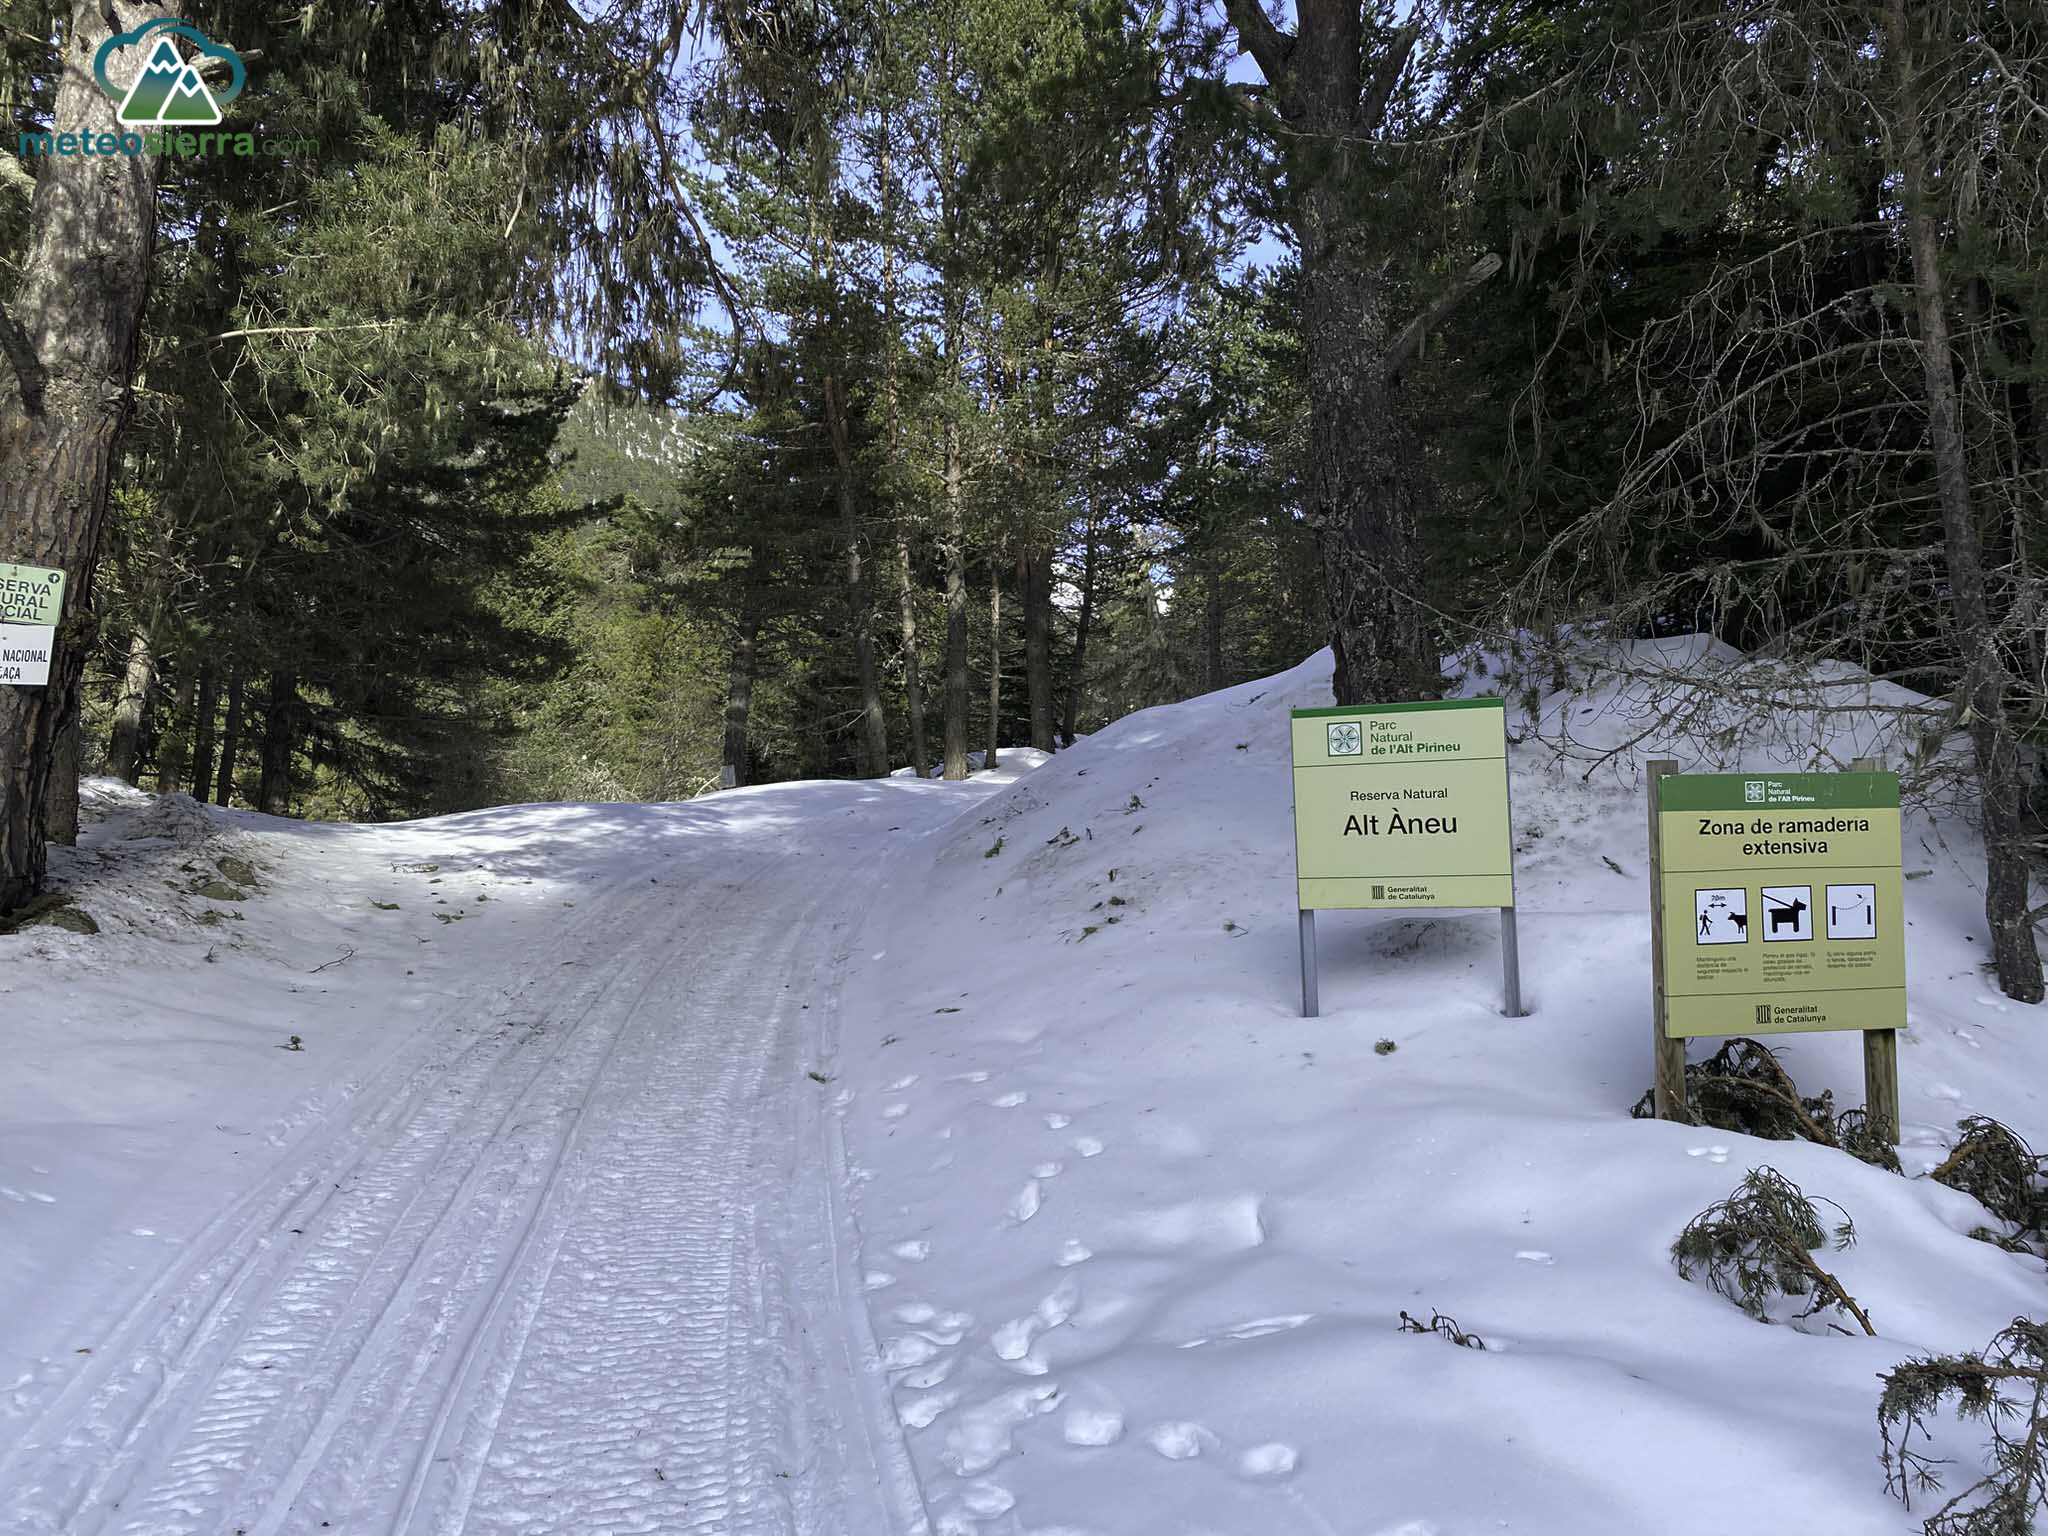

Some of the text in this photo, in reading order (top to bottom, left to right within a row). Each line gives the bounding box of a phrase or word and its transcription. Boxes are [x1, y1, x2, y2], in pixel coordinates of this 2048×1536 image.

[0, 591, 48, 609] URAL
[2, 649, 48, 663] NACIONAL
[1370, 720, 1397, 730] Parc
[1370, 730, 1413, 743] Natural
[1371, 742, 1461, 755] de l'Alt Pirineu
[1350, 787, 1448, 801] Reserva Natural
[1343, 807, 1458, 836] Alt Àneu
[1699, 817, 1869, 835] Zona de ramaderia
[1742, 838, 1828, 855] extensiva
[1398, 893, 1436, 901] Catalunya
[1774, 1005, 1818, 1014] Generalitat
[1774, 1014, 1827, 1024] de Catalunya
